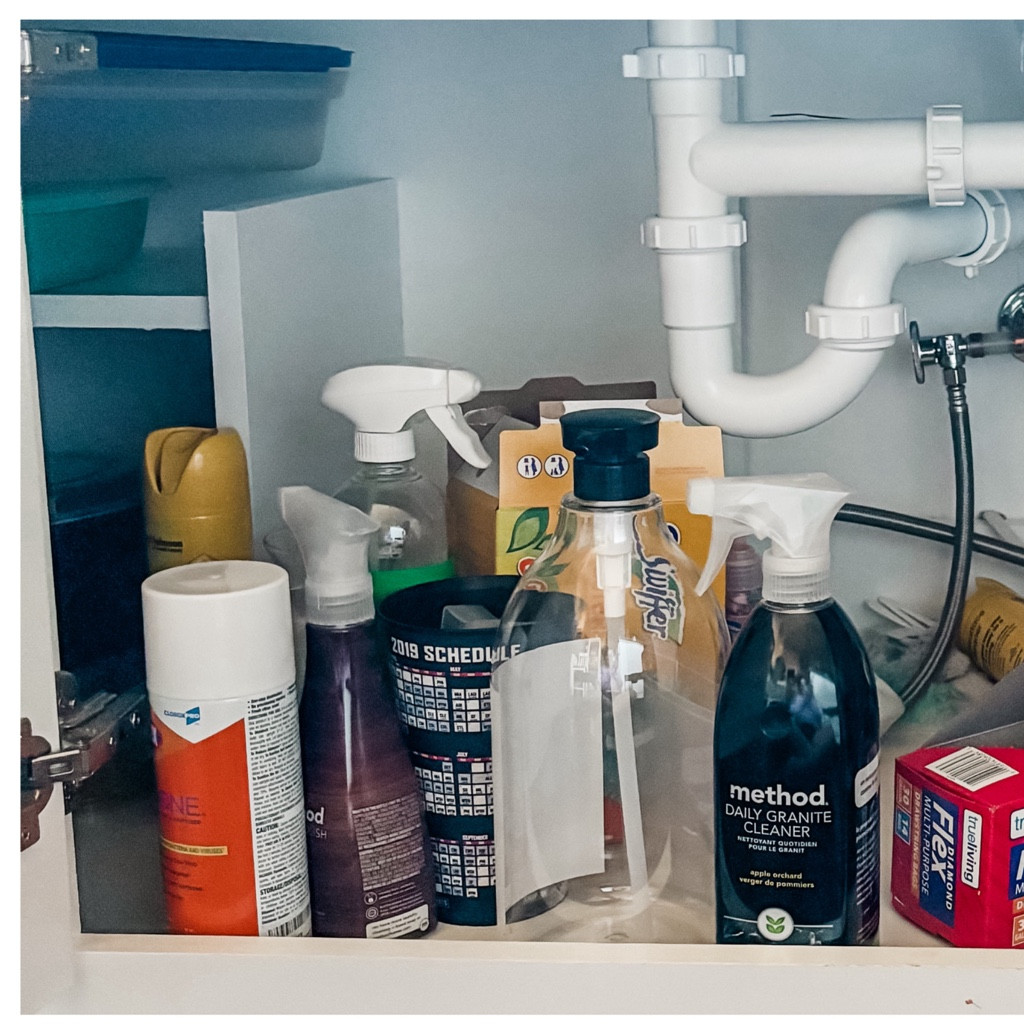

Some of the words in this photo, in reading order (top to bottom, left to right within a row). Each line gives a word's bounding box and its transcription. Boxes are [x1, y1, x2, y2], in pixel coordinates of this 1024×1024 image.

[632, 514, 677, 640] Swiffer
[391, 637, 419, 659] 2019
[424, 643, 521, 663] SCHEDULE
[725, 803, 762, 820] DAILY
[766, 810, 832, 824] GRANITE
[737, 835, 776, 846] NETTOYANT
[778, 840, 818, 848] QUOTIDIEN
[743, 821, 810, 838] CLEANER
[931, 801, 954, 884] Flex
[921, 795, 932, 897] MULTI-PURPOSE
[963, 815, 978, 883] trueliving
[739, 876, 763, 887] verger
[765, 879, 775, 887] de
[776, 881, 815, 889] pommiers
[750, 869, 771, 878] apple
[945, 846, 955, 911] DIAMOND
